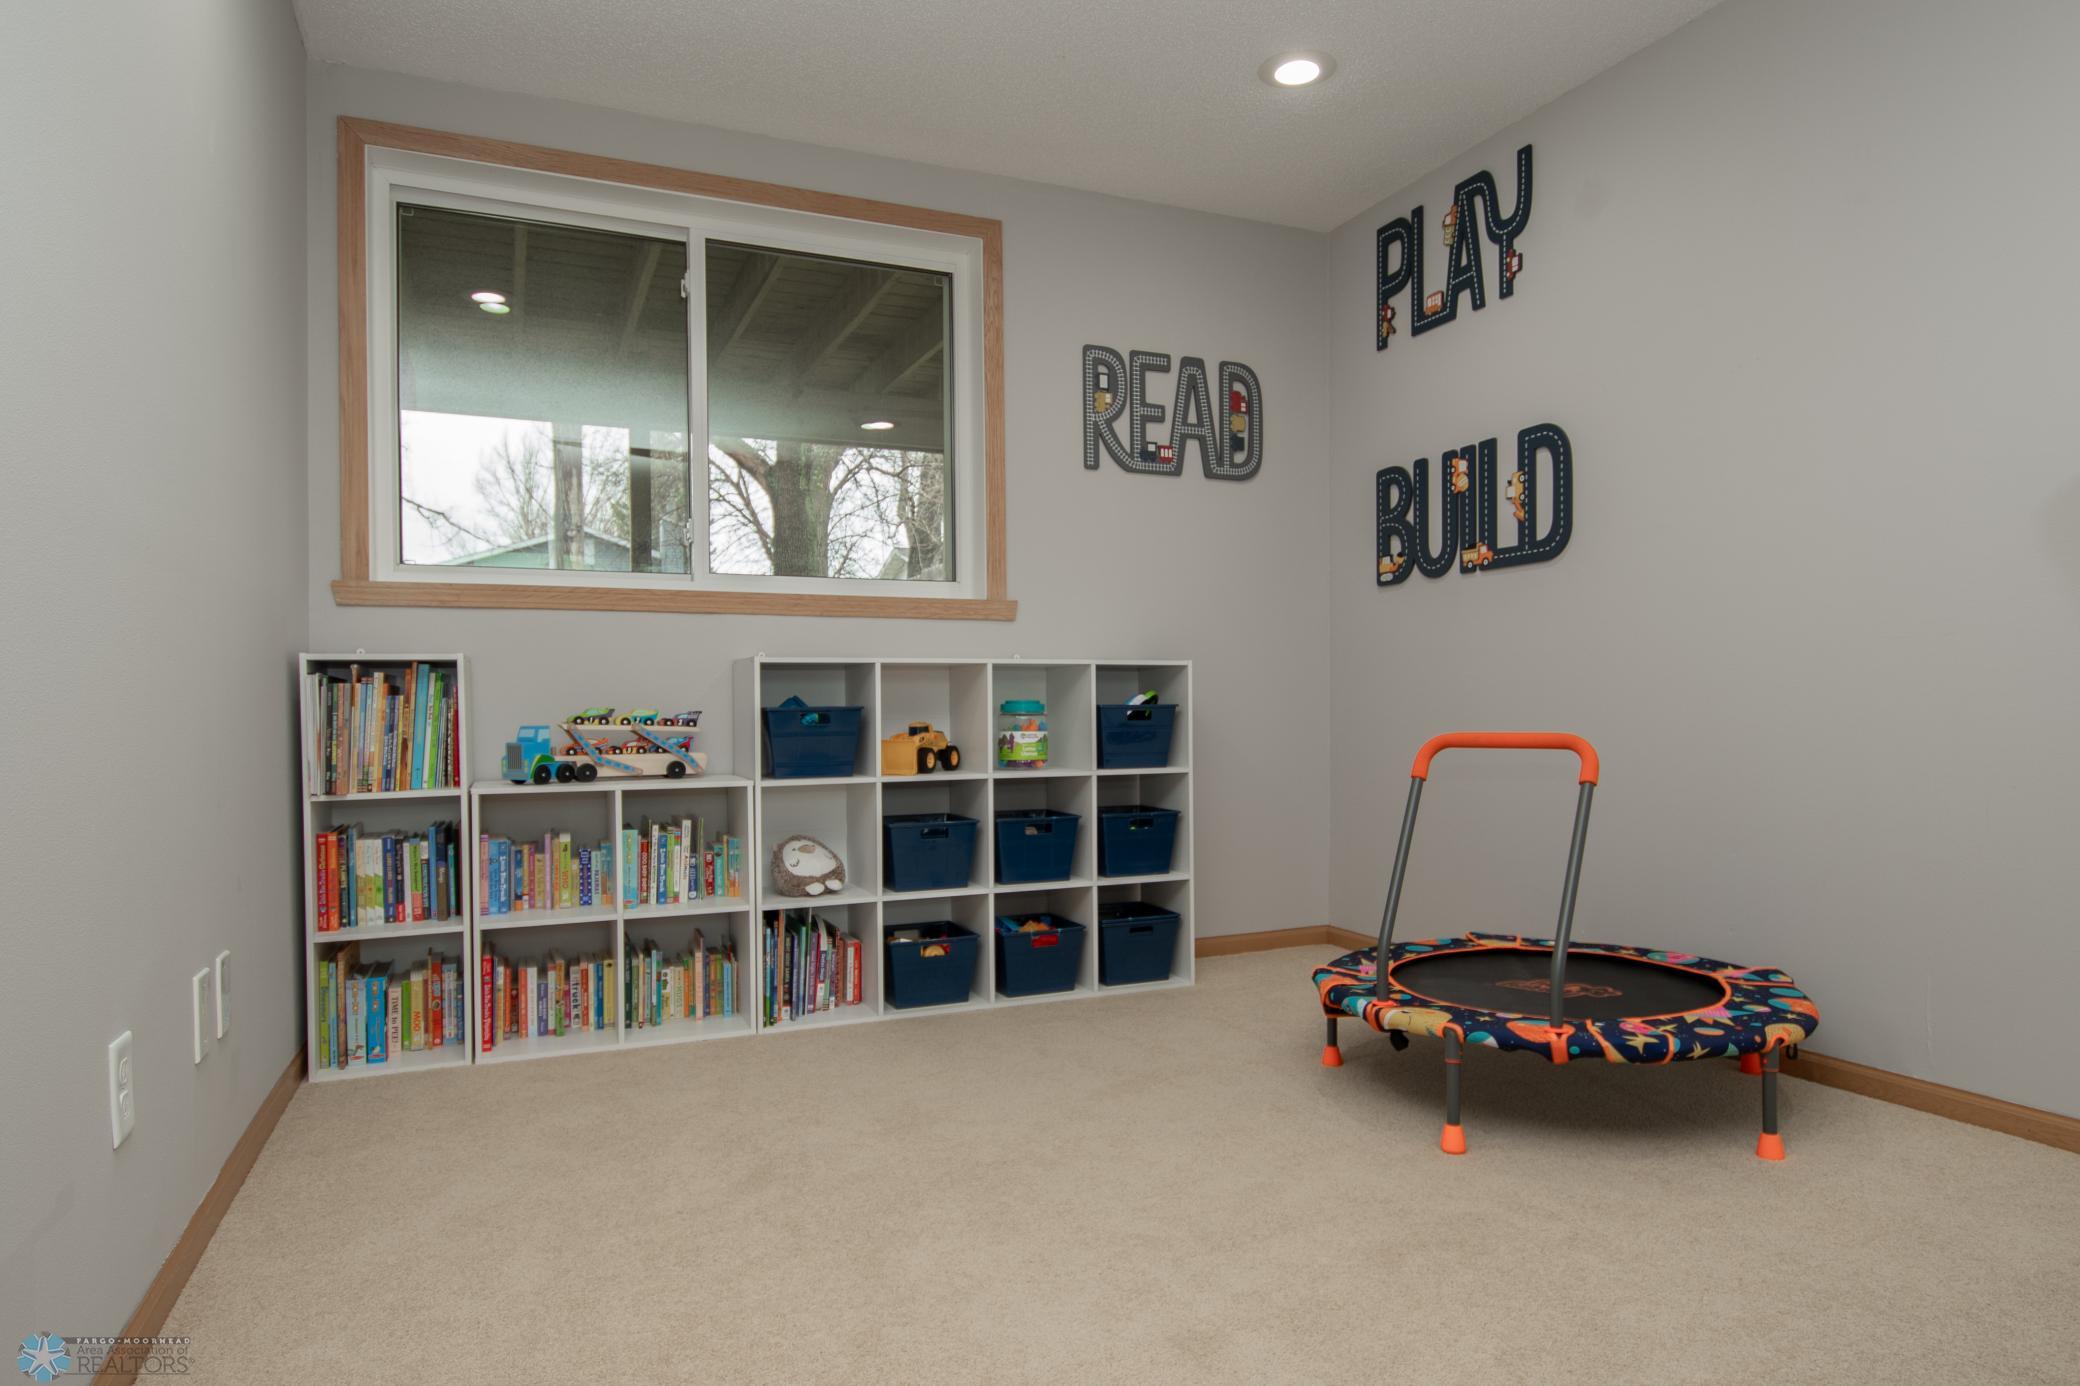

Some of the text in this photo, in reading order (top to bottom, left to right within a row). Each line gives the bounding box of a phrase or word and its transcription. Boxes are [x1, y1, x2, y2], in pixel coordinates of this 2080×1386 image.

[1377, 144, 1533, 351] PLAY
[1083, 344, 1263, 481] READ
[1375, 423, 1573, 587] BUILD
